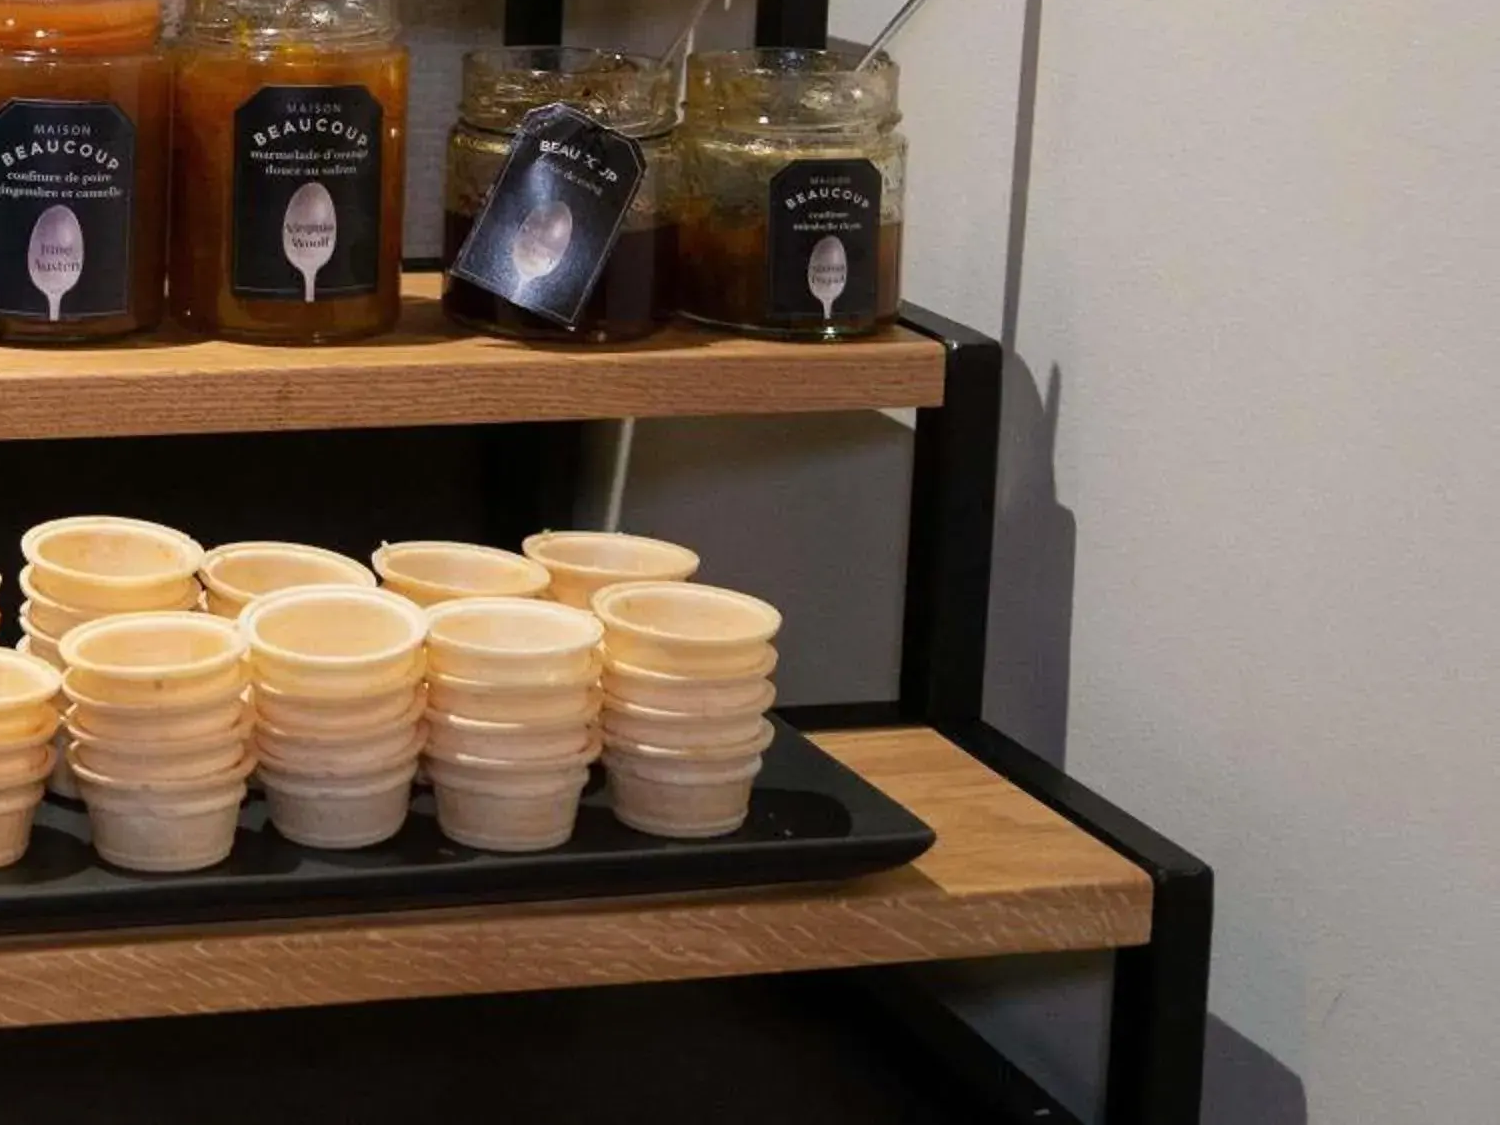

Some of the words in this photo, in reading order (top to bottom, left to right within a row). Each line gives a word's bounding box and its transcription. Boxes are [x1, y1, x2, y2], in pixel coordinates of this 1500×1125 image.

[286, 103, 342, 114] MAISON
[33, 124, 91, 136] MAISON
[253, 117, 368, 147] BEAUCOUP
[1, 139, 120, 171] BEAUCOUP
[540, 140, 581, 161] BEAU
[583, 154, 597, 170] X
[7, 170, 62, 183] confiture
[65, 172, 78, 183] de
[785, 186, 870, 210] BEAUCOUP
